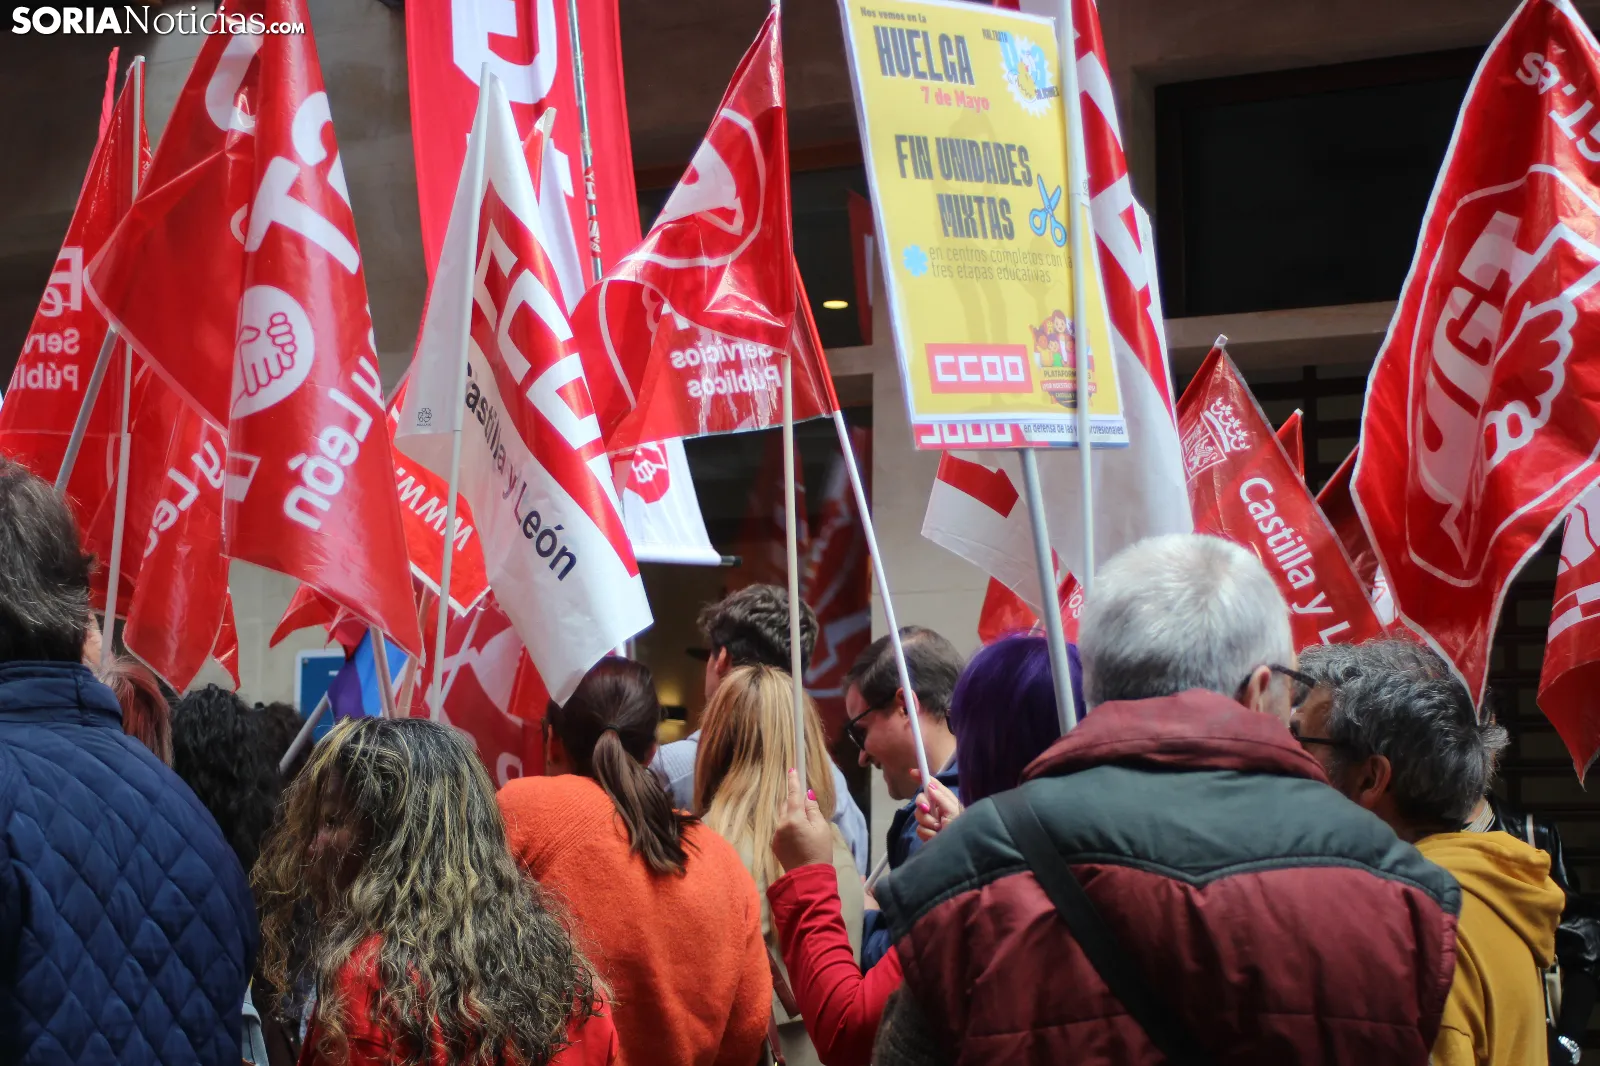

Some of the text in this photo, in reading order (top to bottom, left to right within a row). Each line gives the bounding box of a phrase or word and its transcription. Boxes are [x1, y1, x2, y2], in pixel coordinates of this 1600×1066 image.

[860, 6, 927, 23] Nos vemos en la
[873, 25, 975, 86] HUELGA
[920, 86, 989, 113] 7 de Mayo
[895, 134, 1033, 187] FIN UNIDADES
[936, 193, 1015, 240] MIXTAS
[929, 246, 944, 261] en
[947, 248, 987, 263] centros
[991, 249, 1044, 267] completos
[1046, 254, 1062, 267] con
[932, 262, 1051, 283] tres etapas educativas
[934, 355, 1025, 382] CCOO
[466, 363, 506, 476] astilla
[513, 480, 577, 581] León
[1239, 477, 1316, 589] Castilla
[1292, 591, 1335, 614] y
